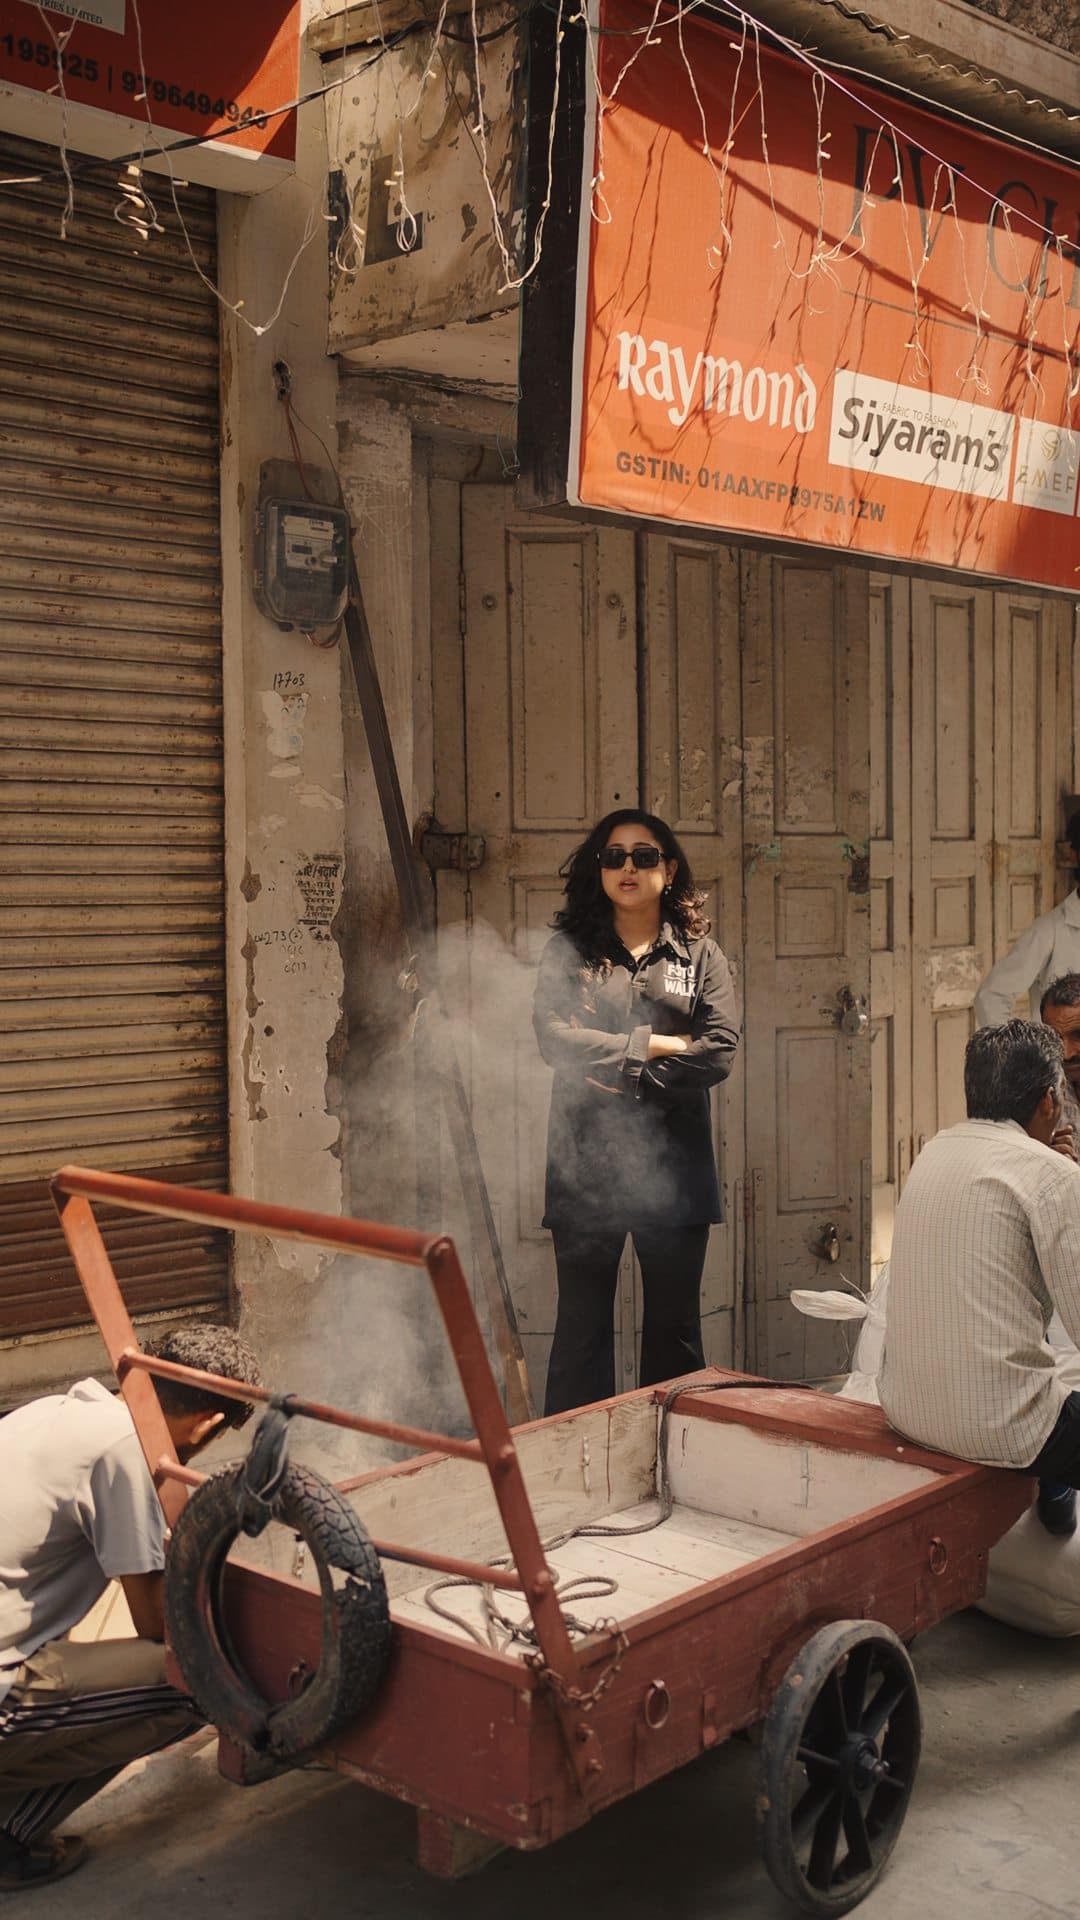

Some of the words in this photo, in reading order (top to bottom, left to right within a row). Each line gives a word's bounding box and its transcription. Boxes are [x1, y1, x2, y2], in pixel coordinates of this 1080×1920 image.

[615, 330, 818, 434] Raymond
[881, 402, 910, 418] FABRIC
[912, 409, 923, 422] TO
[924, 414, 959, 430] FASHION
[838, 397, 1004, 473] Siyaram's
[615, 451, 691, 485] GSTIN:
[272, 671, 306, 690] 17703
[667, 964, 695, 979] FOTO
[664, 979, 697, 997] WALK
